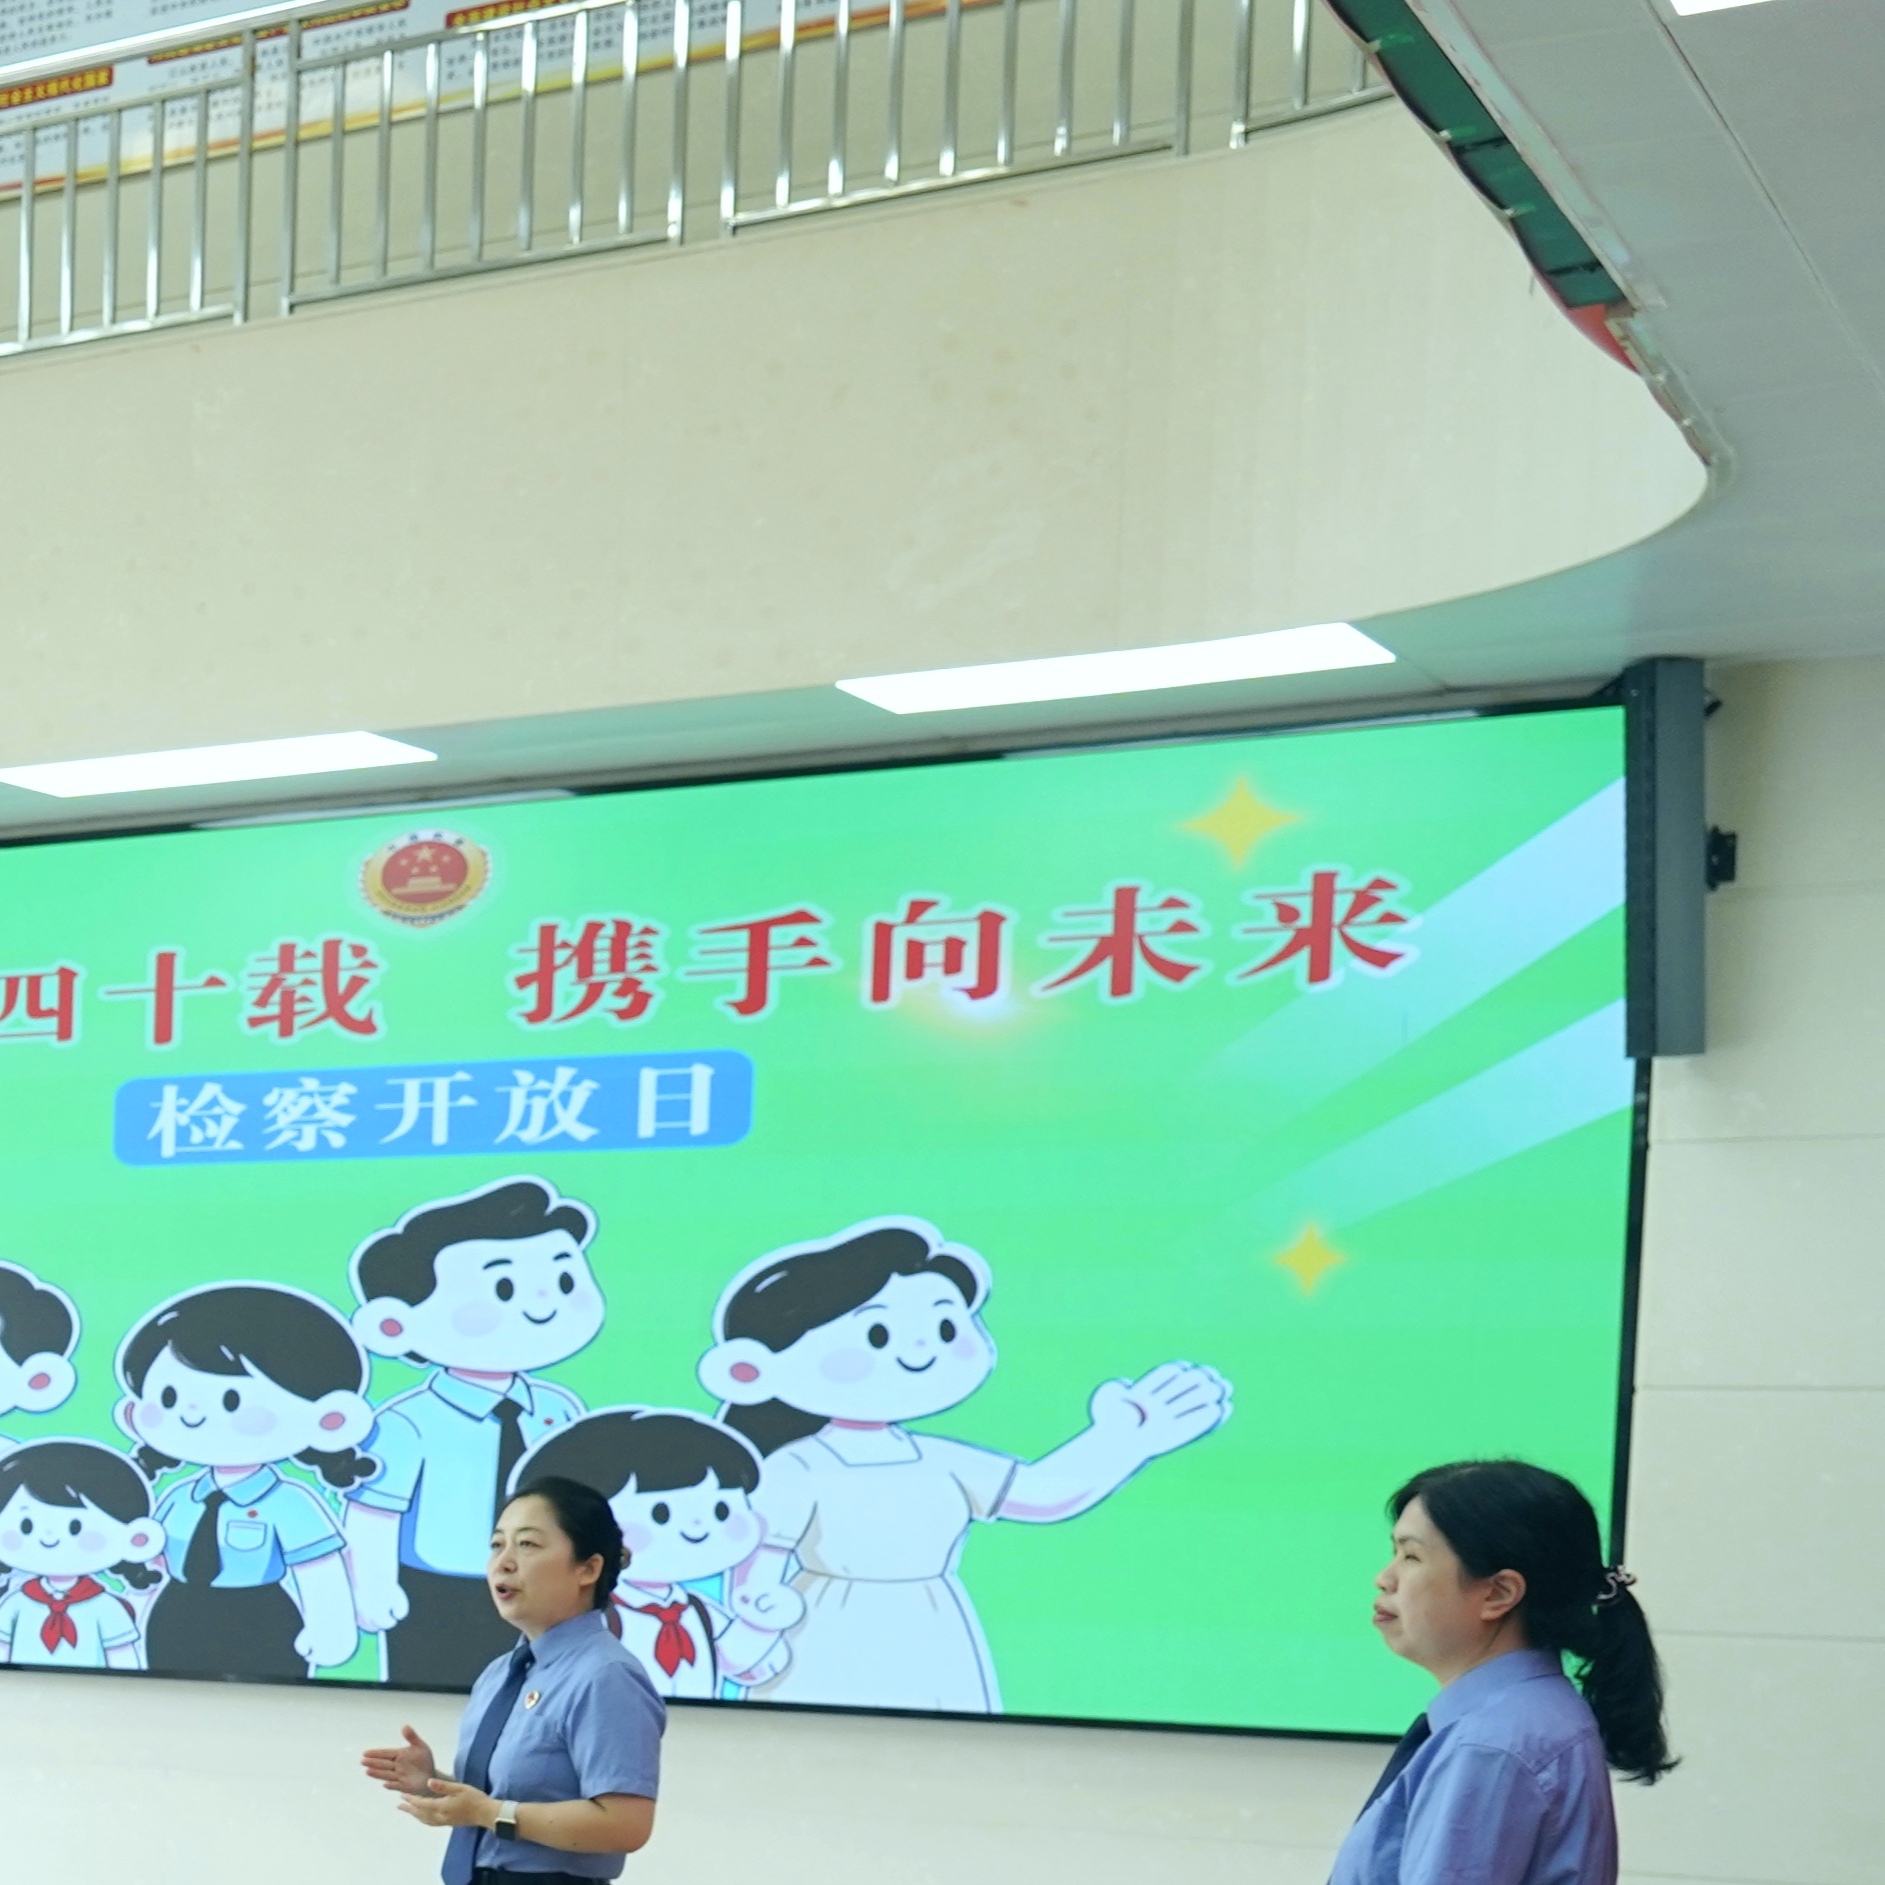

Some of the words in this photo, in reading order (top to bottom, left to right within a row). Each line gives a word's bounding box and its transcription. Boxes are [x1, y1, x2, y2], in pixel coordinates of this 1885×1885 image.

[515, 869, 1407, 1026] 携手向未来
[147, 1061, 717, 1159] 检察开放日
